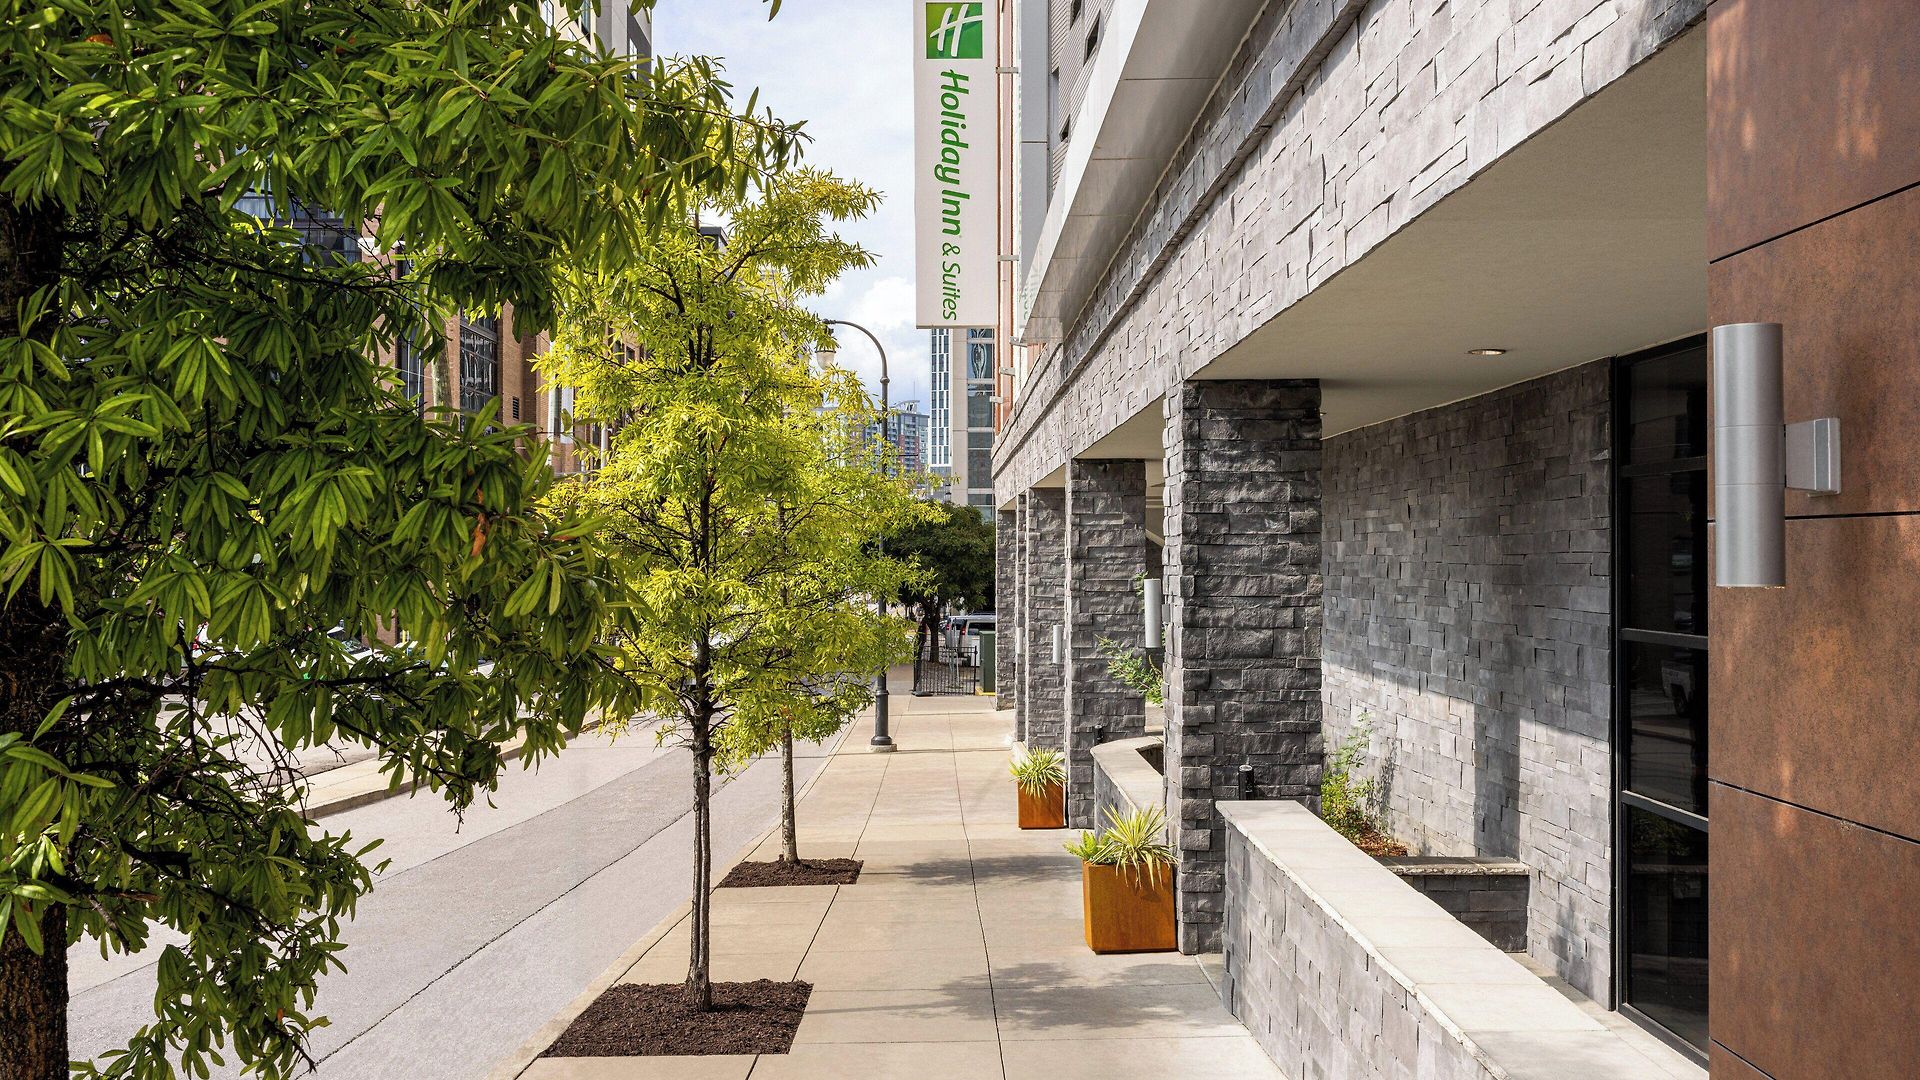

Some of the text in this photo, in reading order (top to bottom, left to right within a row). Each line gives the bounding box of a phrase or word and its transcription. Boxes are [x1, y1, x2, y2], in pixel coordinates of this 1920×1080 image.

[934, 68, 970, 321] Holiday Inn & Suites
